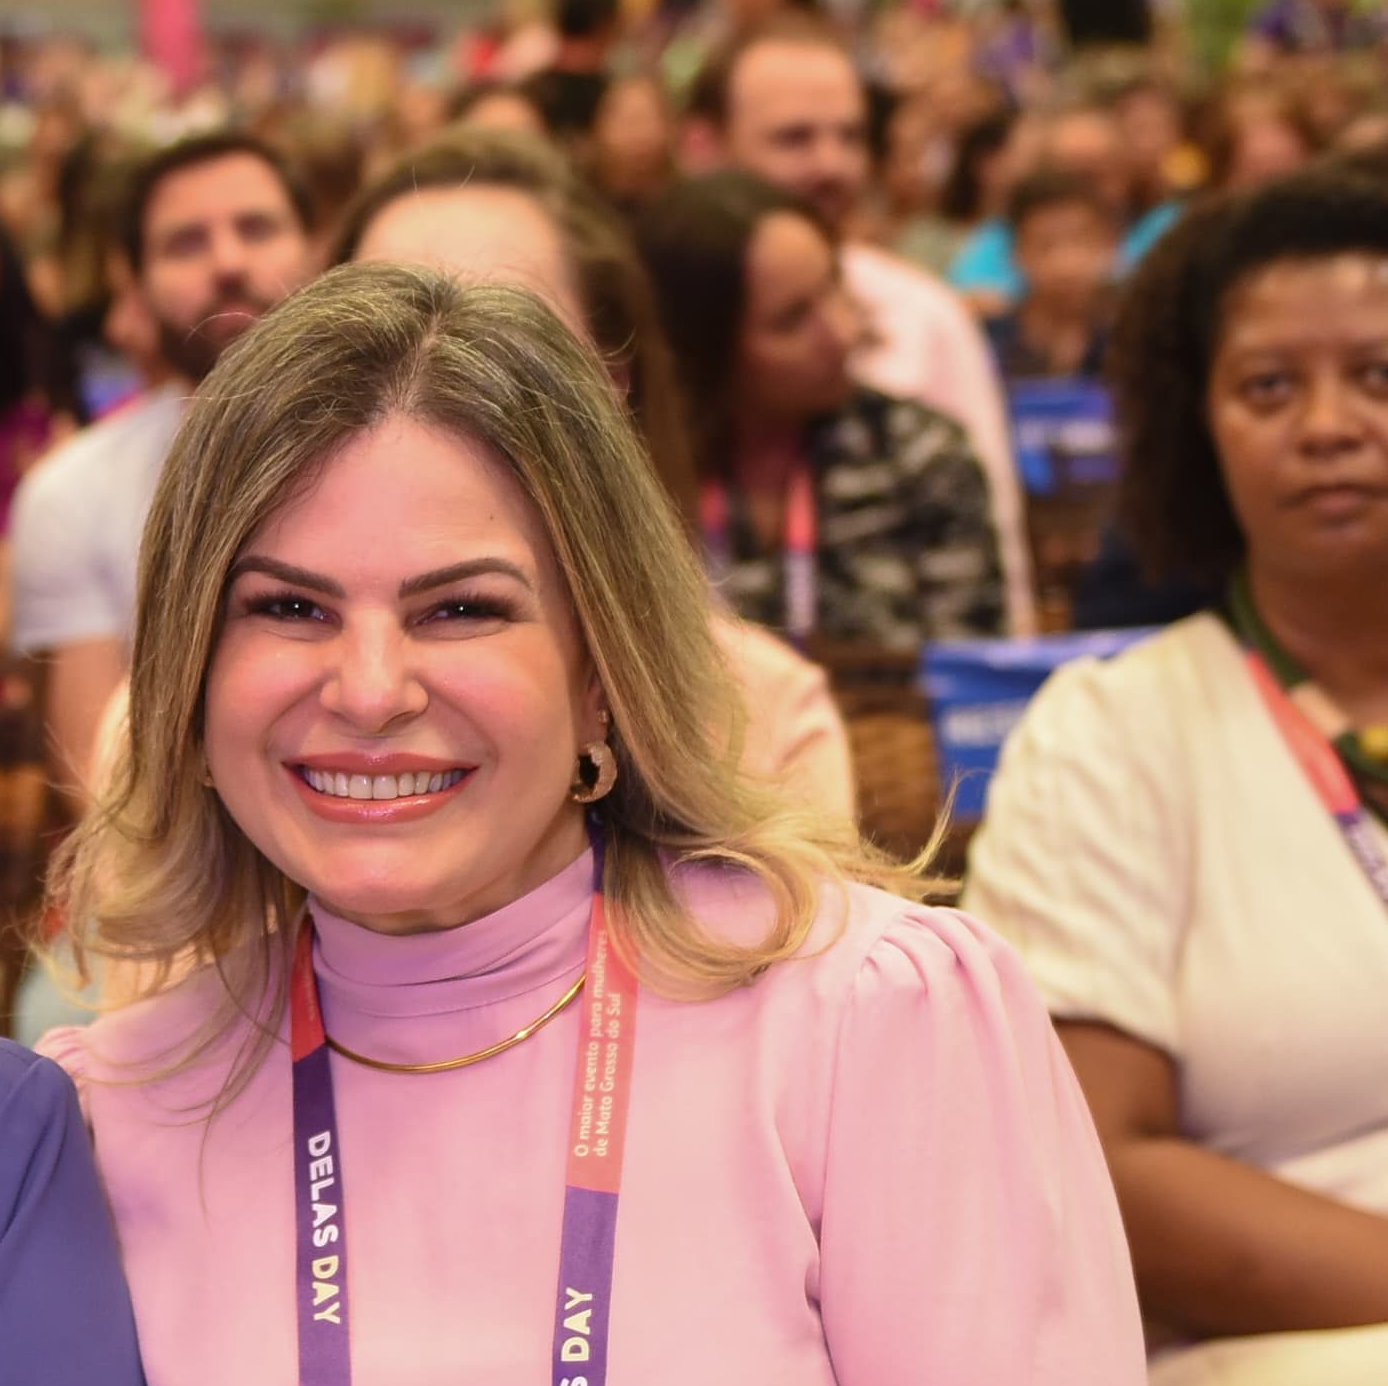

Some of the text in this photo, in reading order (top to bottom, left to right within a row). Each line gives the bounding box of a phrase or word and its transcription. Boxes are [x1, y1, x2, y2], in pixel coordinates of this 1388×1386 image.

[590, 1001, 603, 1038] para
[607, 993, 621, 1016] Sul
[584, 1041, 599, 1092] evento
[599, 1042, 619, 1092] Grosso
[578, 1095, 594, 1140] maior
[595, 1095, 613, 1136] Mato
[574, 1144, 589, 1157] O
[592, 1137, 608, 1157] de
[308, 1130, 341, 1324] DELAS DAY
[560, 1287, 593, 1362] DAY
